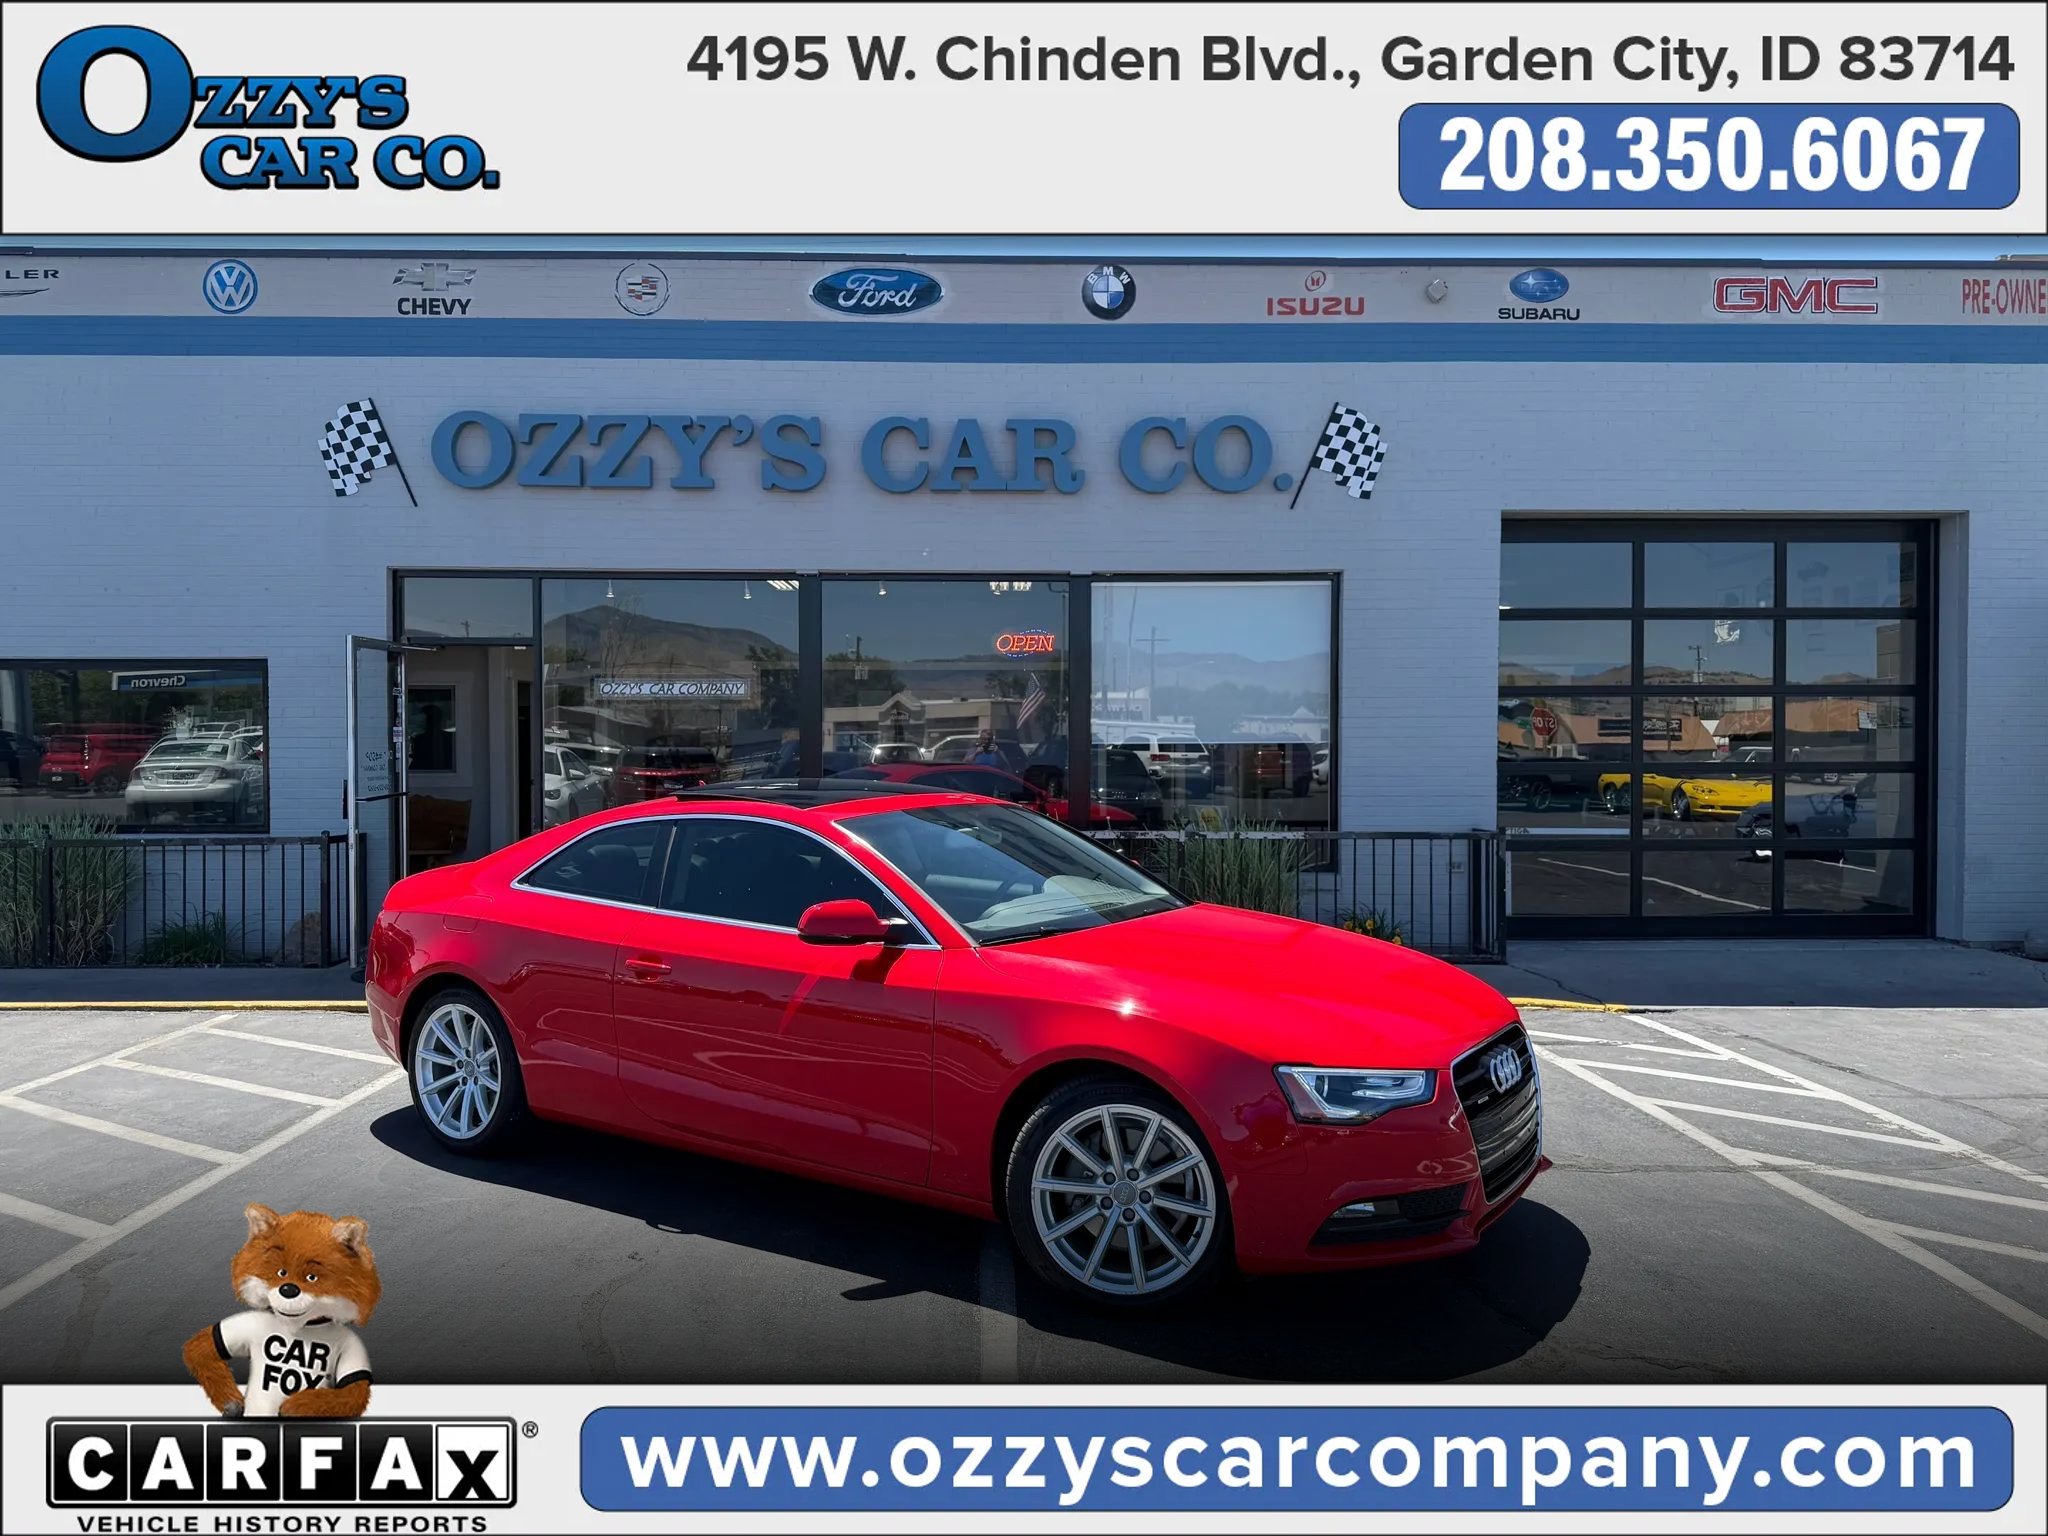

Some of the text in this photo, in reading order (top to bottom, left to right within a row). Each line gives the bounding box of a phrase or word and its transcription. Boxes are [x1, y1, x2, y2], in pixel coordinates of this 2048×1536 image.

[1087, 266, 1131, 289] BMW
[837, 274, 917, 309] Ford
[1713, 277, 1880, 313] GMC
[1962, 278, 2048, 314] PRE-OWNE
[397, 297, 470, 316] CHEVY
[1267, 297, 1364, 316] ISUZU
[1498, 308, 1581, 321] SUBARU
[430, 410, 1294, 496] OZZY'S CAR CO.
[996, 633, 1054, 652] OPEN
[601, 683, 743, 695] OZZY'S CAR COMPANY
